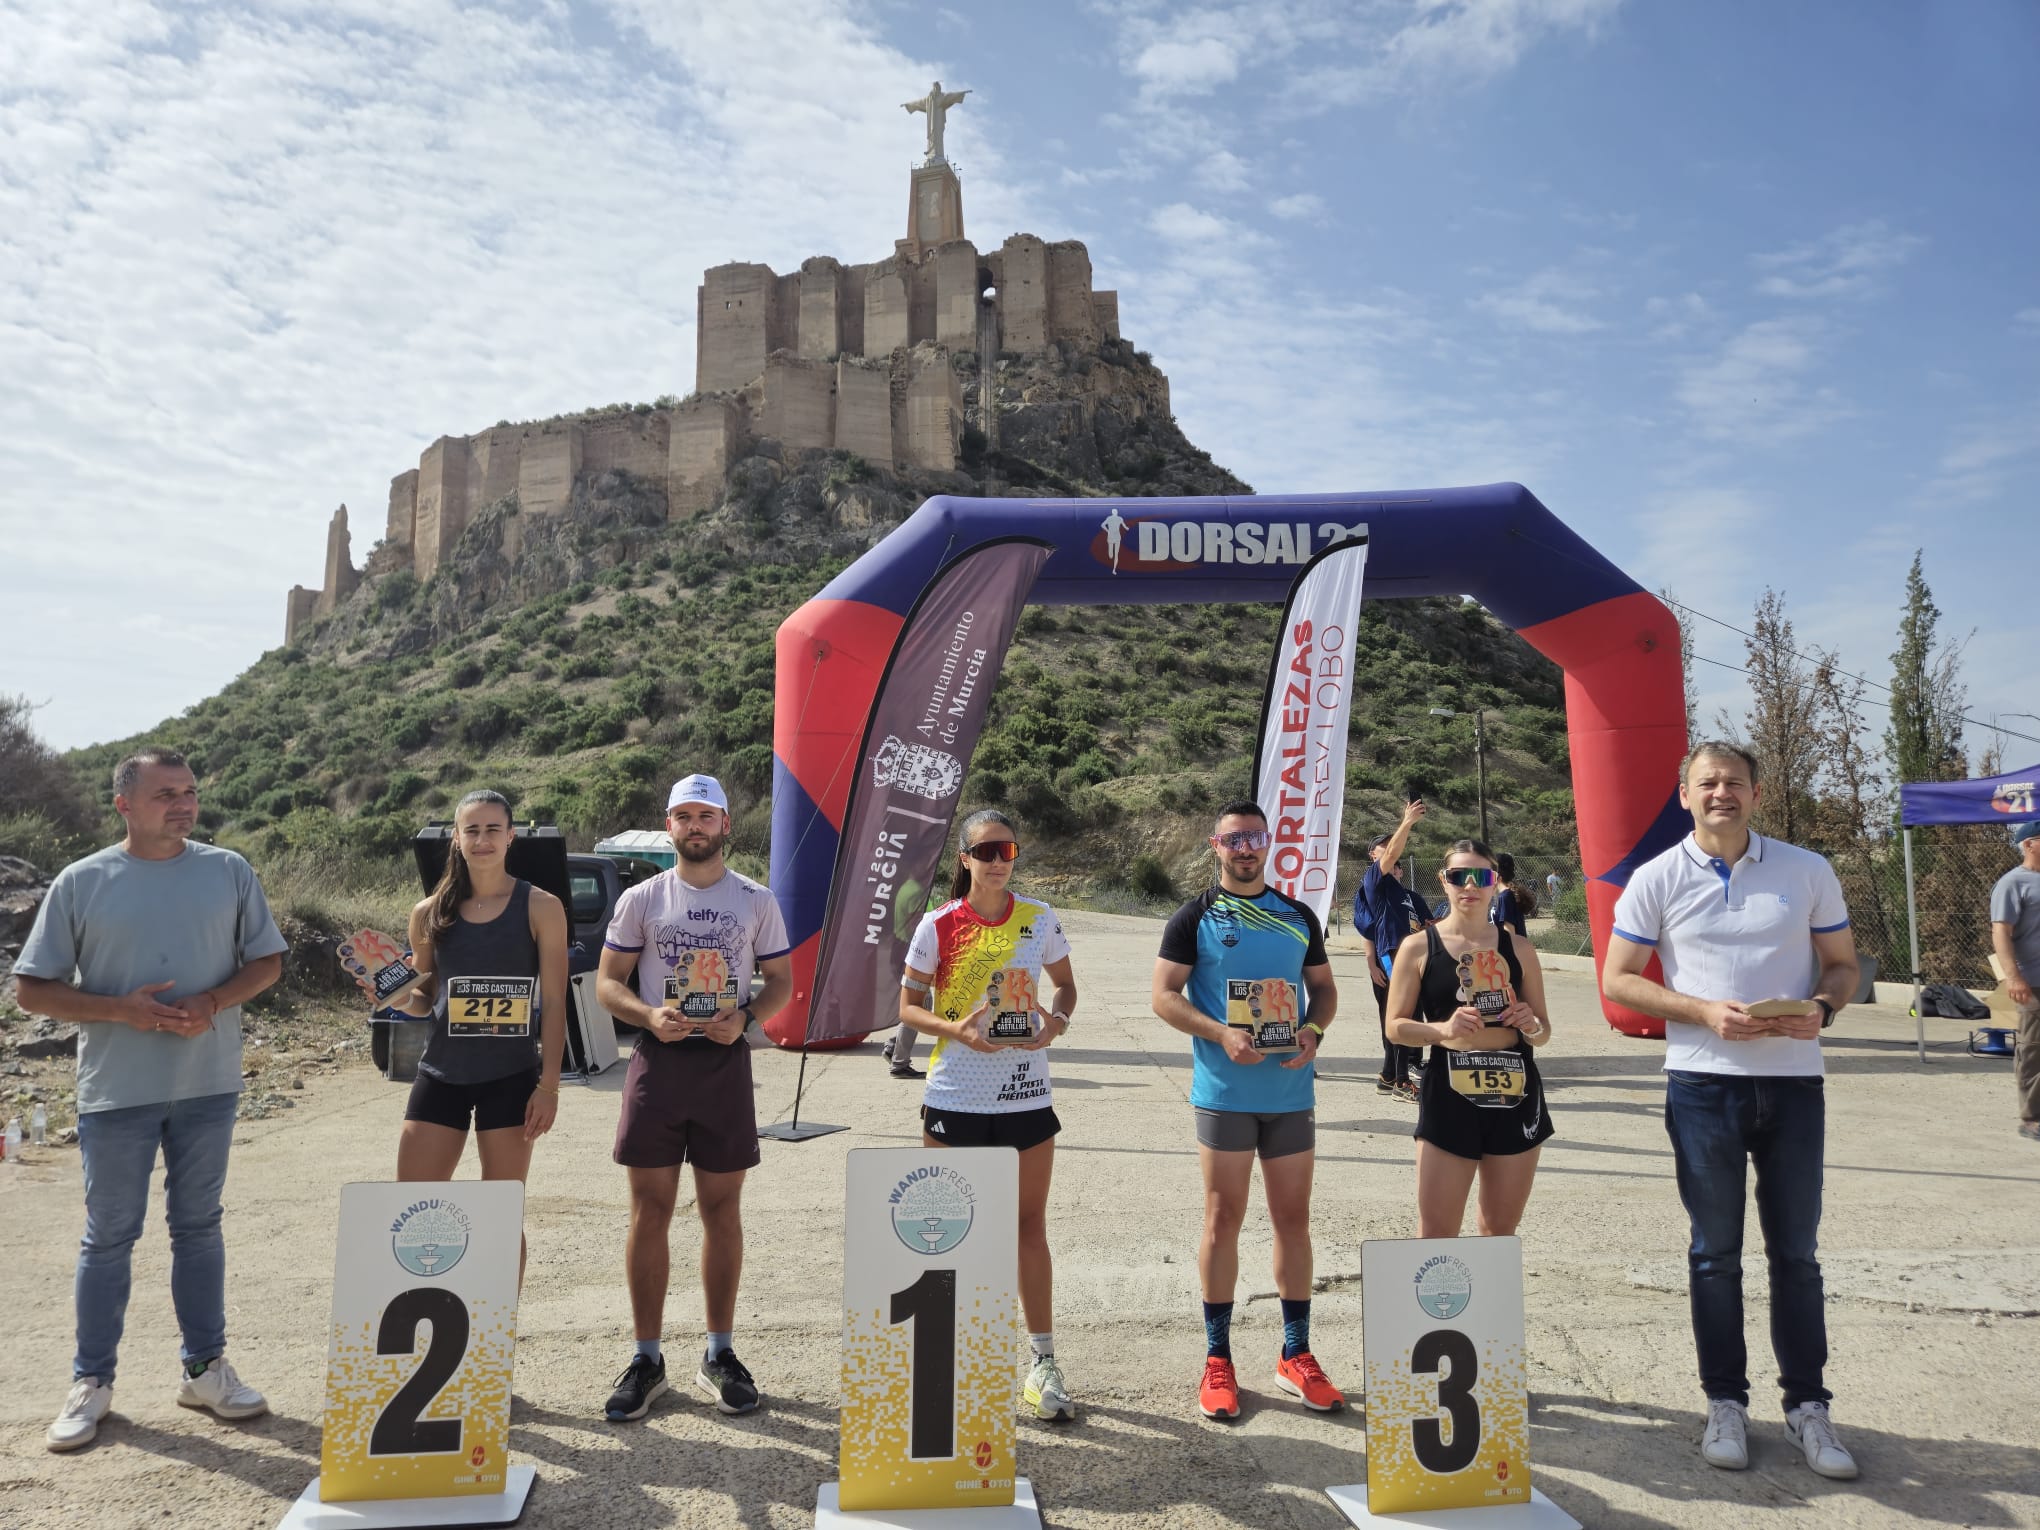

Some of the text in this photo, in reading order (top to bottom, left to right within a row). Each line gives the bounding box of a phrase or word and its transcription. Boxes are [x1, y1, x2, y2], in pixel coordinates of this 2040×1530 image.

[916, 611, 974, 738] Ayuntamiento
[939, 648, 987, 745] de Murcia
[2007, 790, 2033, 813] 21
[867, 830, 888, 882] 1200
[1303, 819, 1330, 892] DEL
[863, 833, 908, 945] MURCIA
[687, 908, 719, 923] telfy
[674, 930, 720, 948] MEDIA
[378, 972, 391, 983] LOS
[389, 964, 405, 976] TRES
[379, 968, 409, 990] CASTILLOS
[952, 935, 1010, 1014] ENTRENOS
[471, 983, 490, 993] TRES
[1234, 986, 1248, 996] LOS
[463, 998, 513, 1017] 212
[684, 1003, 716, 1011] CASTILLOS
[1261, 1033, 1291, 1041] CASTILLOS
[1016, 1061, 1030, 1072] TÚ
[1456, 1056, 1520, 1068] LOS TRES CASTILLOS
[1001, 1083, 1016, 1092] LA
[1011, 1073, 1026, 1082] YO
[1469, 1070, 1513, 1089] 153
[888, 1166, 977, 1205] WANDUFRESH
[389, 1198, 473, 1233] WANDUFRESH
[1413, 1255, 1473, 1284] WANDUFRESH
[370, 1288, 469, 1456] 2
[889, 1269, 956, 1459] 1
[1411, 1329, 1480, 1473] 3
